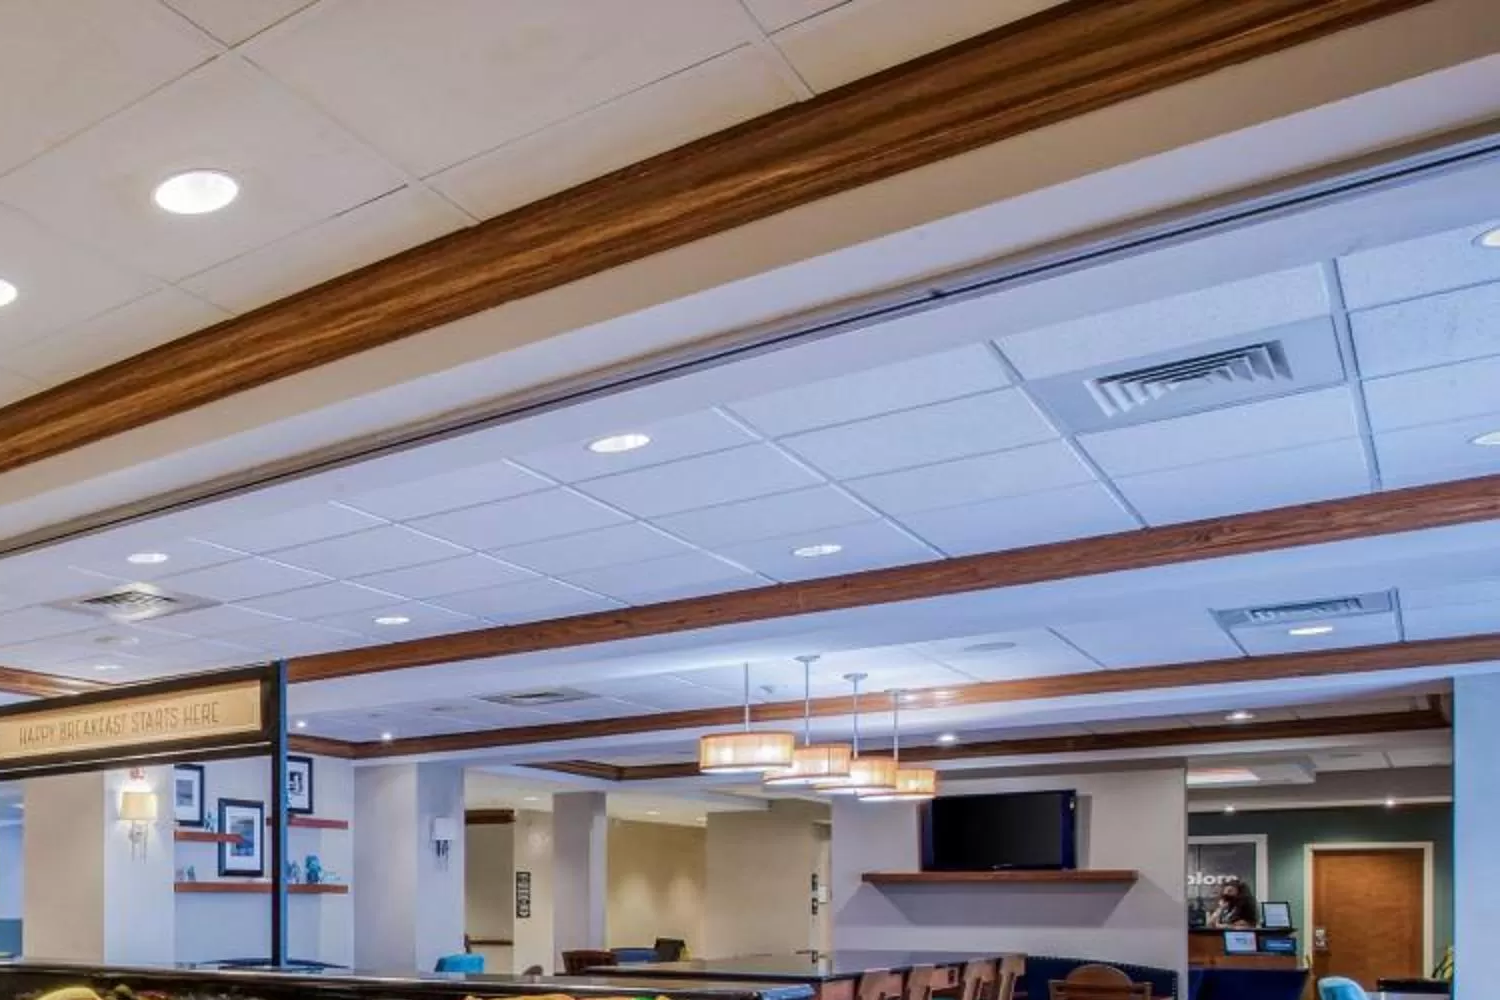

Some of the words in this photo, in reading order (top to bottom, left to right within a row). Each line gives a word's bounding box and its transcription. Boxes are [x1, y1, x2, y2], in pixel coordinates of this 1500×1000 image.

[19, 723, 55, 746] HAPPY
[58, 712, 127, 742] BREAKFAST
[131, 706, 179, 733] STARTS
[183, 702, 220, 726] HERE
